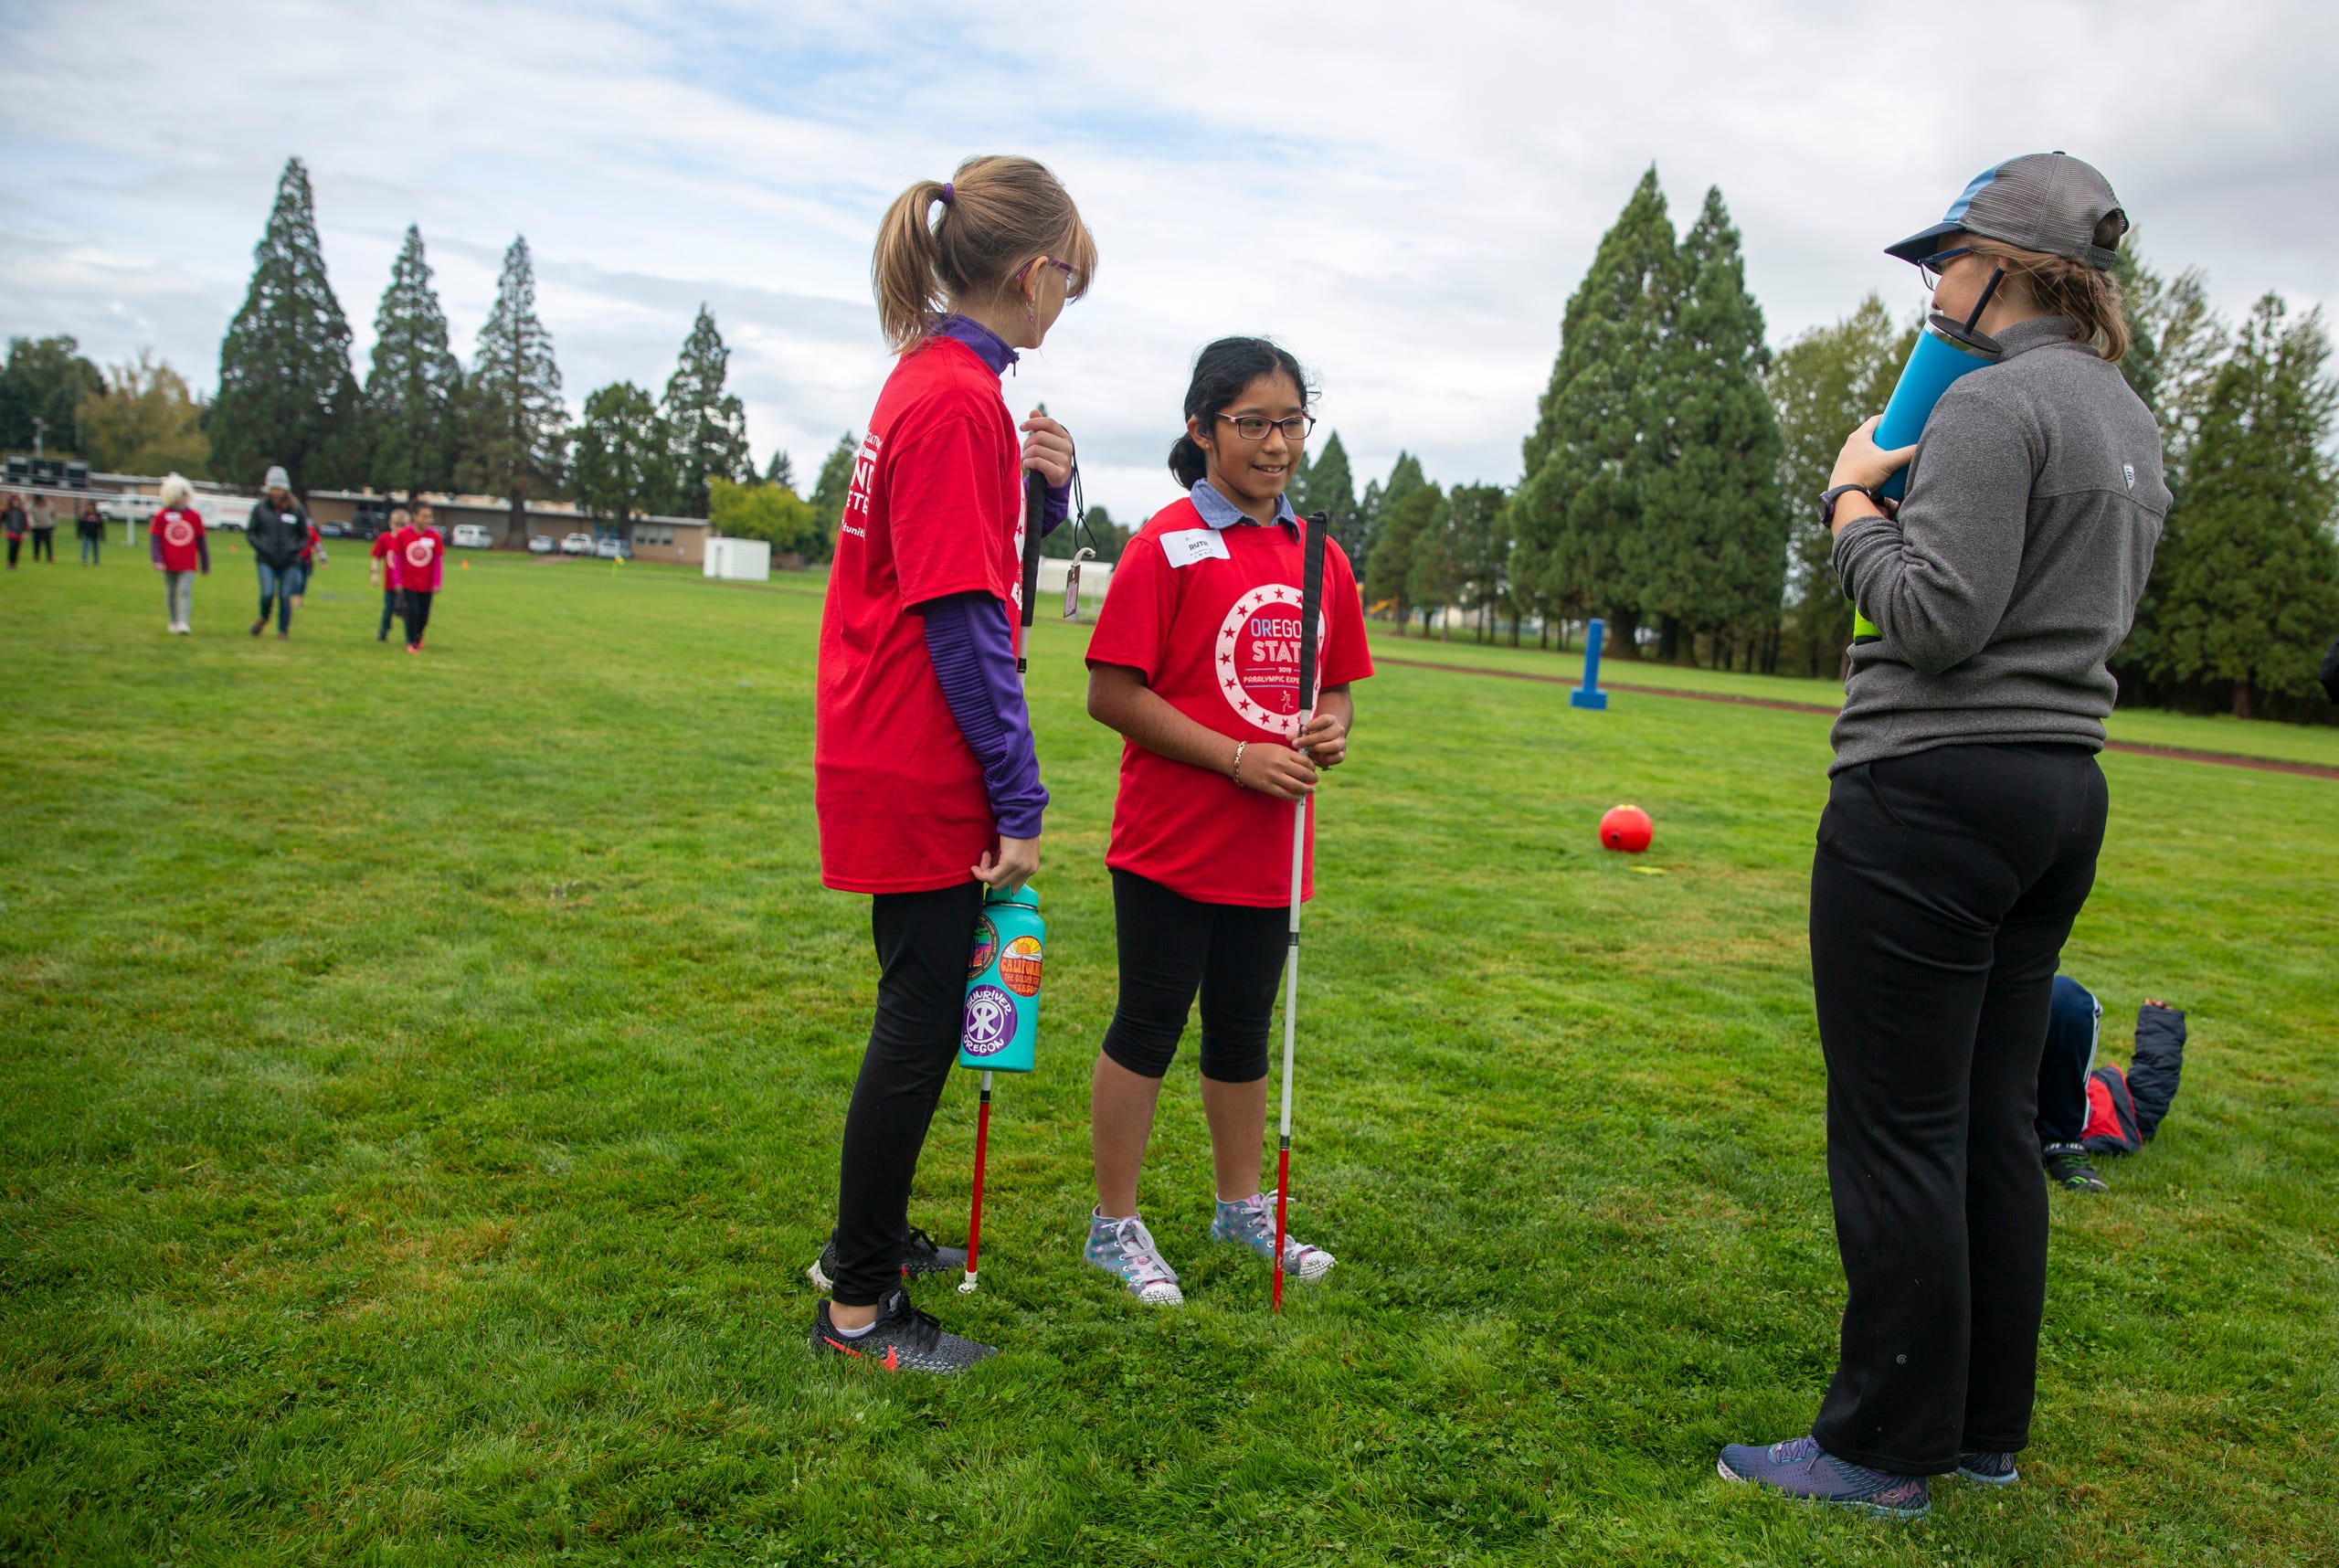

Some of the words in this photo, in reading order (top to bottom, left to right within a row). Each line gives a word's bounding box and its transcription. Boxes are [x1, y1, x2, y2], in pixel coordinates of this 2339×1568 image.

[1251, 618, 1302, 639] OREGO
[1252, 640, 1302, 663] STAT
[1243, 675, 1286, 683] PARALYMPIC
[1286, 676, 1300, 684] EXPE
[1278, 666, 1293, 674] 2019
[967, 990, 1011, 1016] SUNRIVER
[964, 1034, 1004, 1053] OREGON
